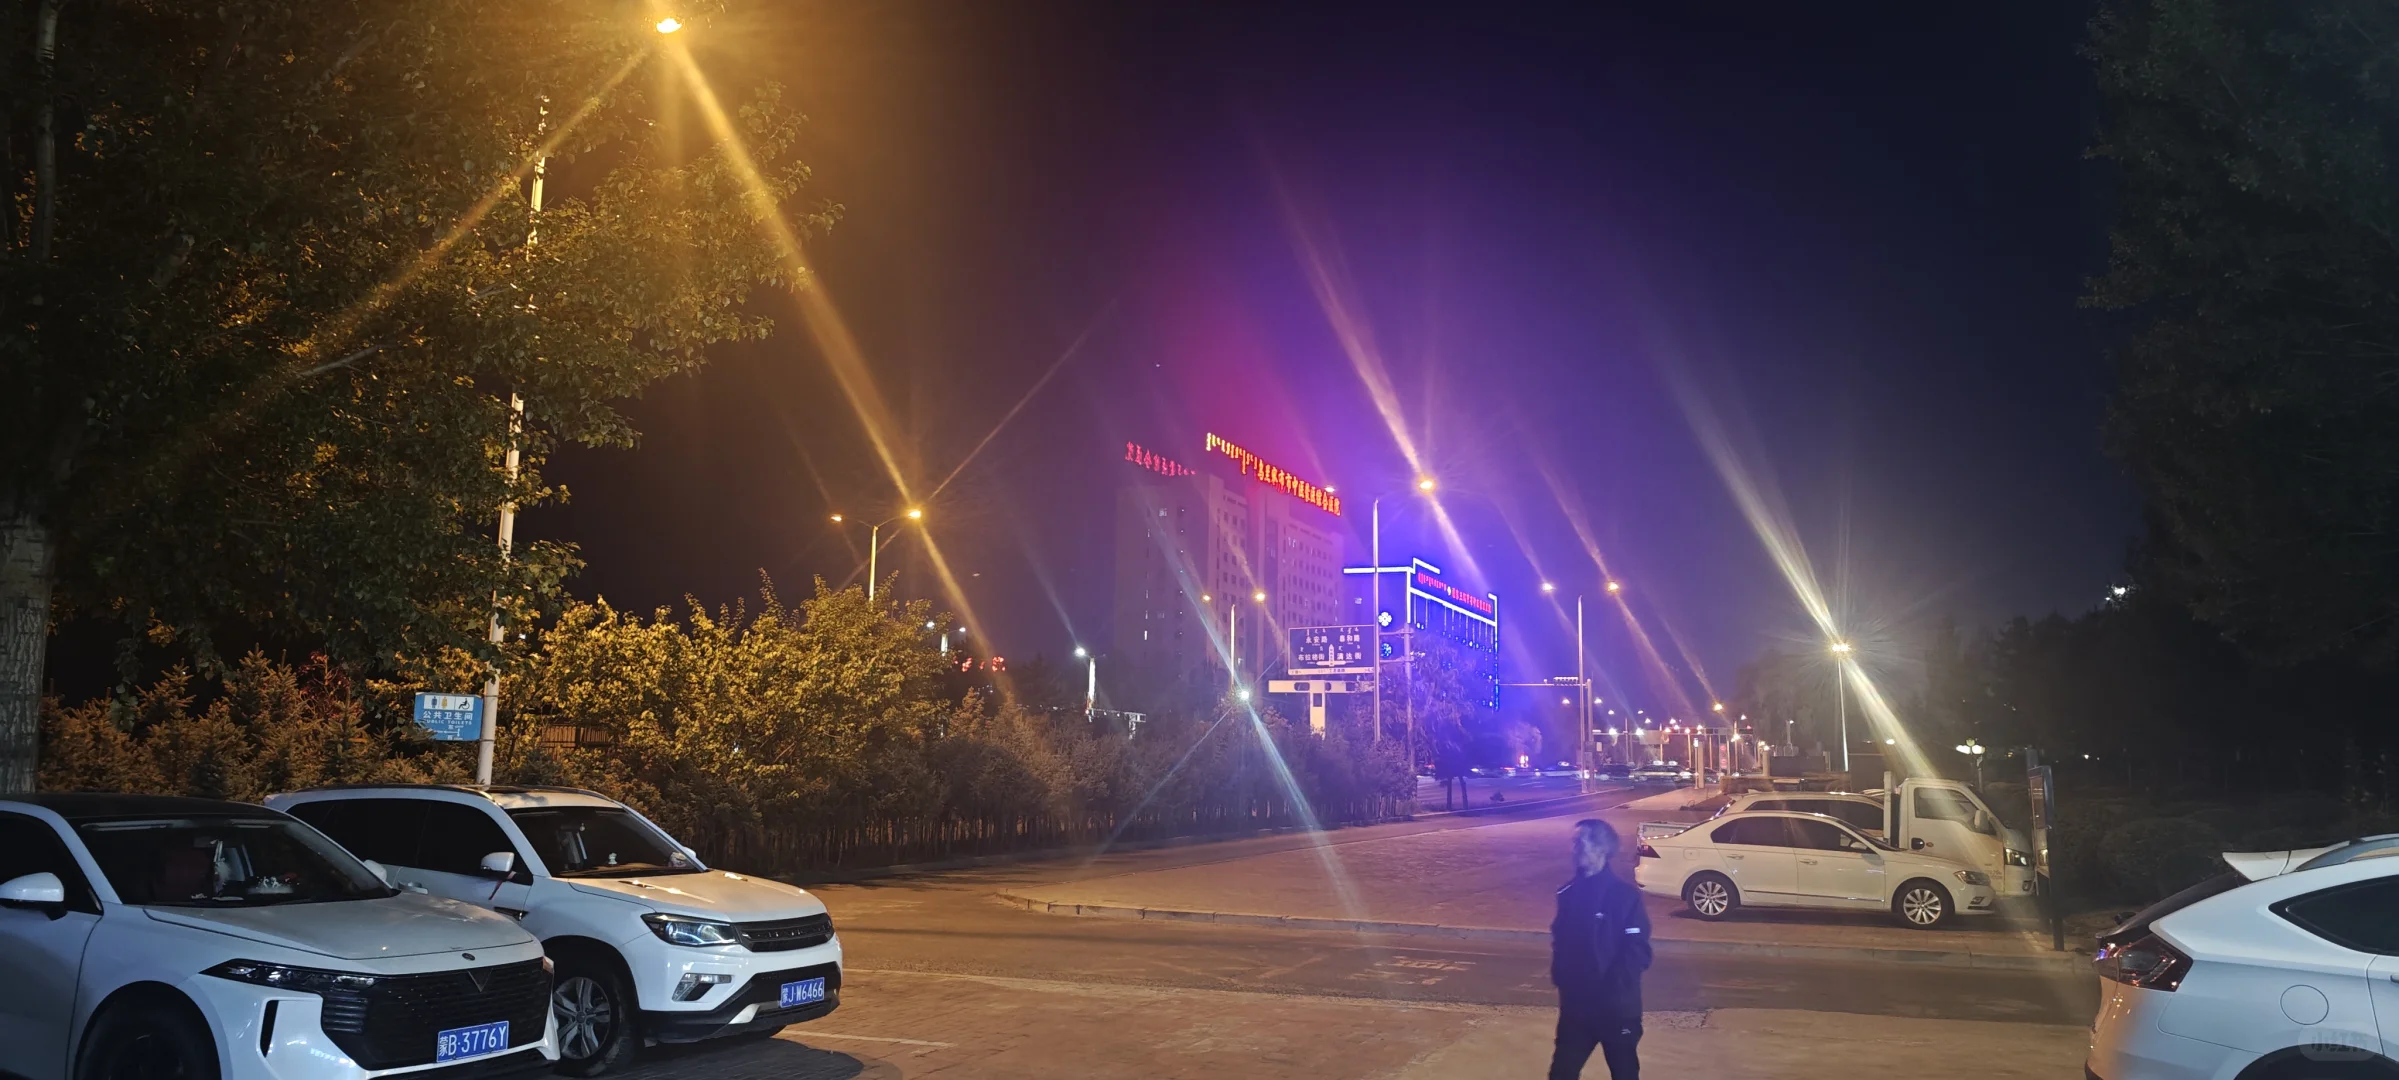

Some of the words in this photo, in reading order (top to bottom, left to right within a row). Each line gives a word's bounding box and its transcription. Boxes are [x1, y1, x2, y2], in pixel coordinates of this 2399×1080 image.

[423, 710, 473, 721] 公共卫生间
